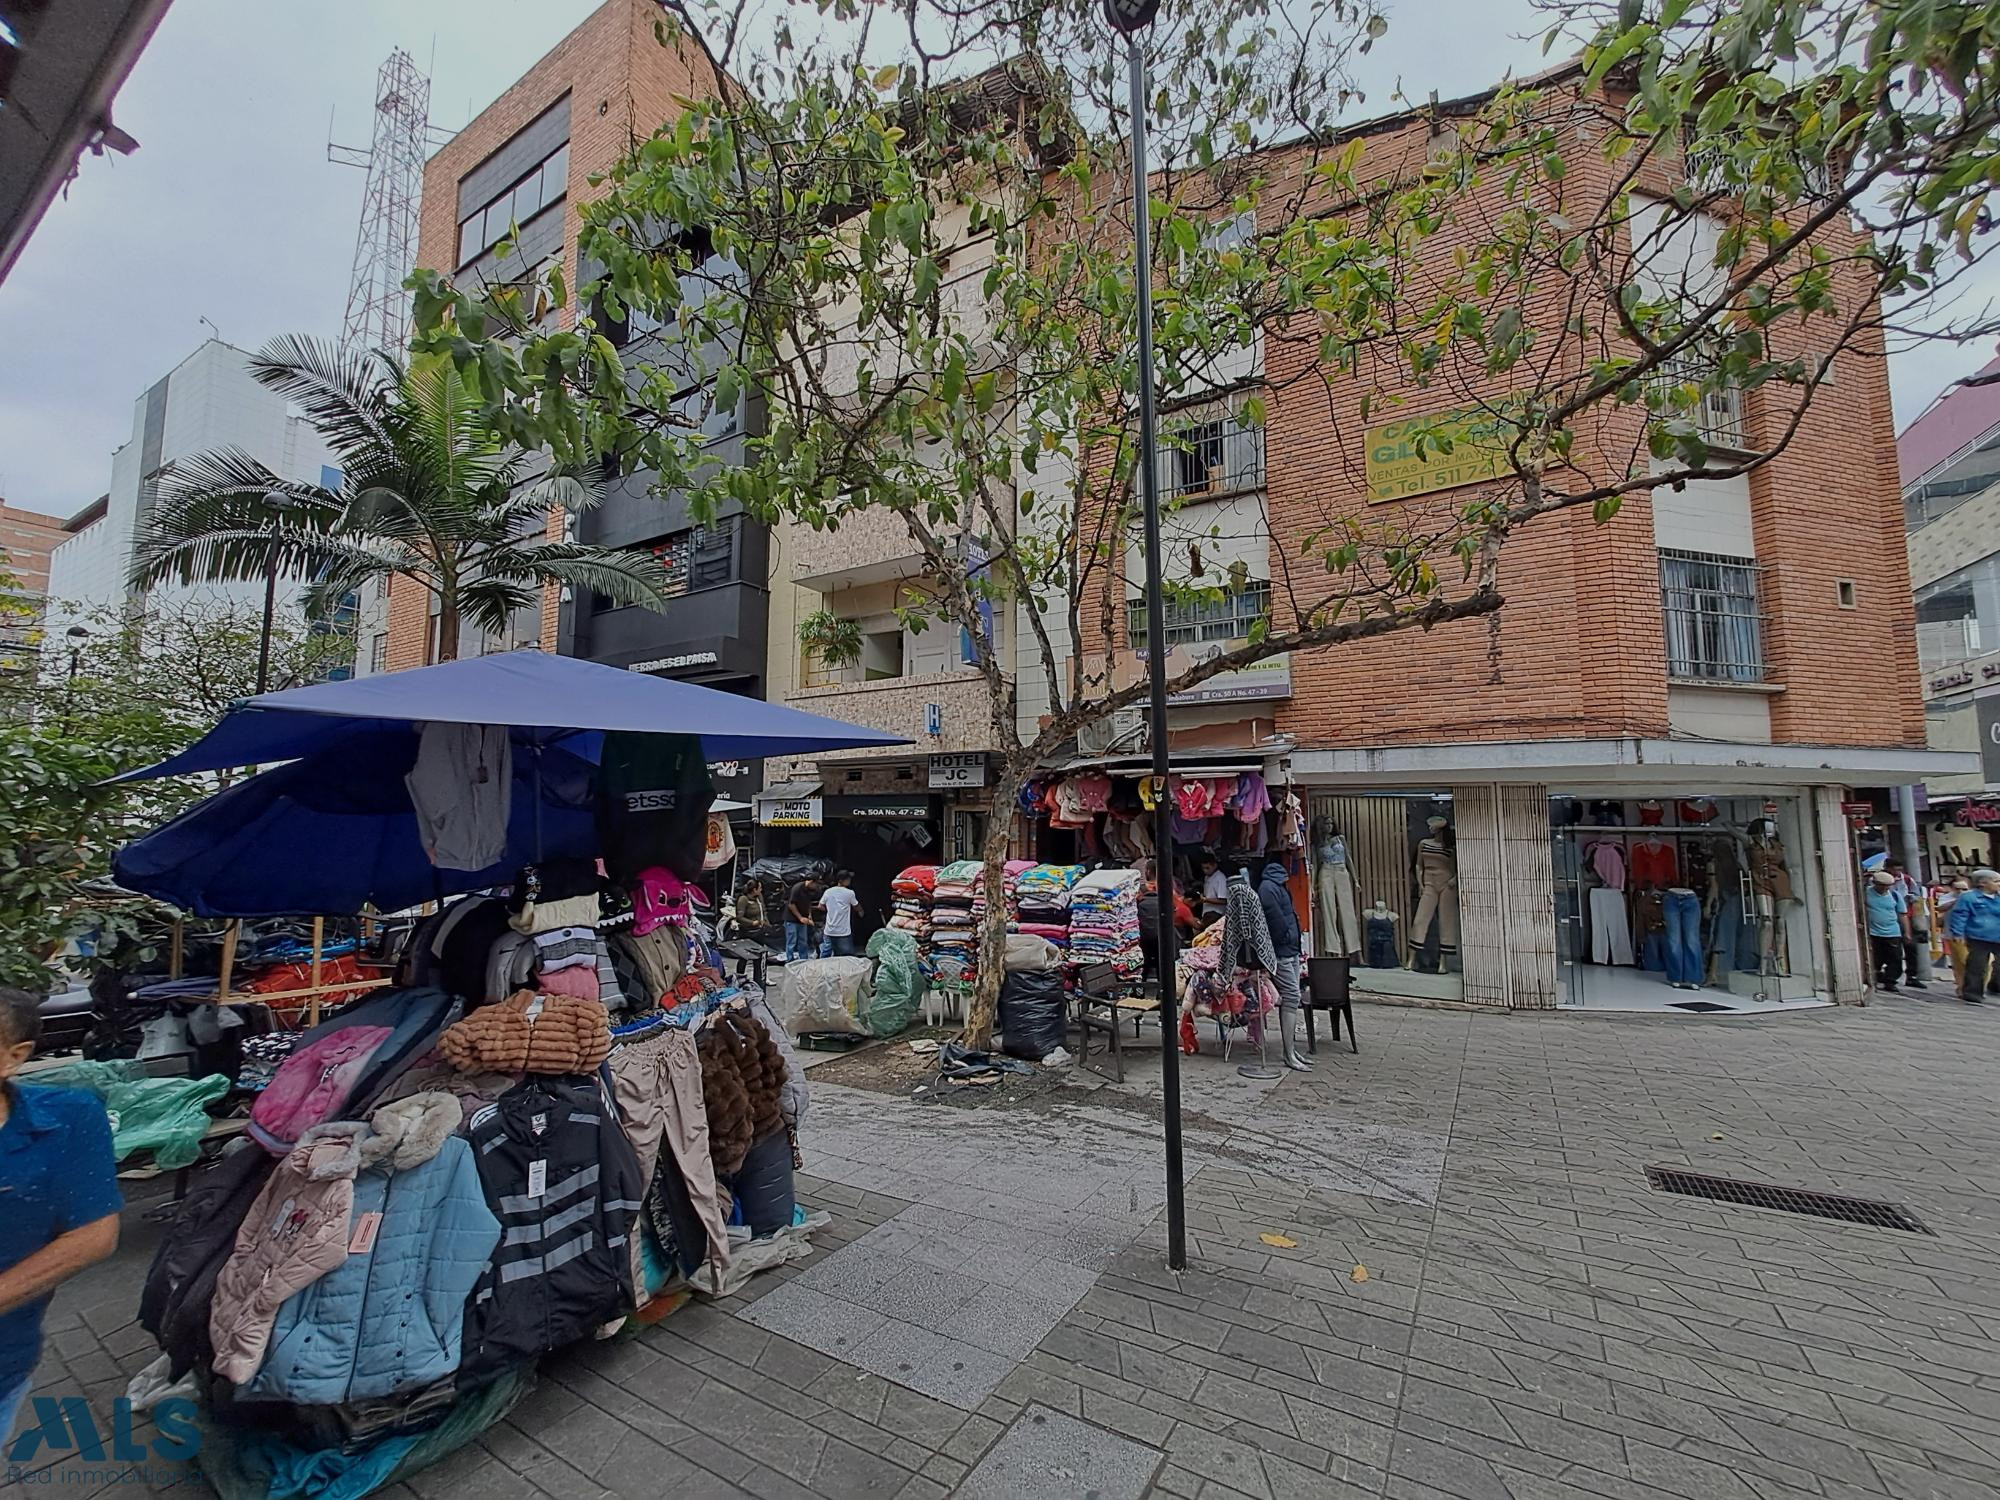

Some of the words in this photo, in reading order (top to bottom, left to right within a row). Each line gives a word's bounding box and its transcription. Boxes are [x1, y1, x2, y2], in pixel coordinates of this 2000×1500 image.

[1369, 463, 1418, 481] VENTAS
[1424, 455, 1450, 470] POR
[1396, 474, 1430, 494] Tel.
[1435, 469, 1461, 486] 511
[930, 755, 984, 767] HOTEL
[945, 769, 968, 780] JC
[784, 802, 811, 811] MOTO
[772, 811, 811, 820] PARKING
